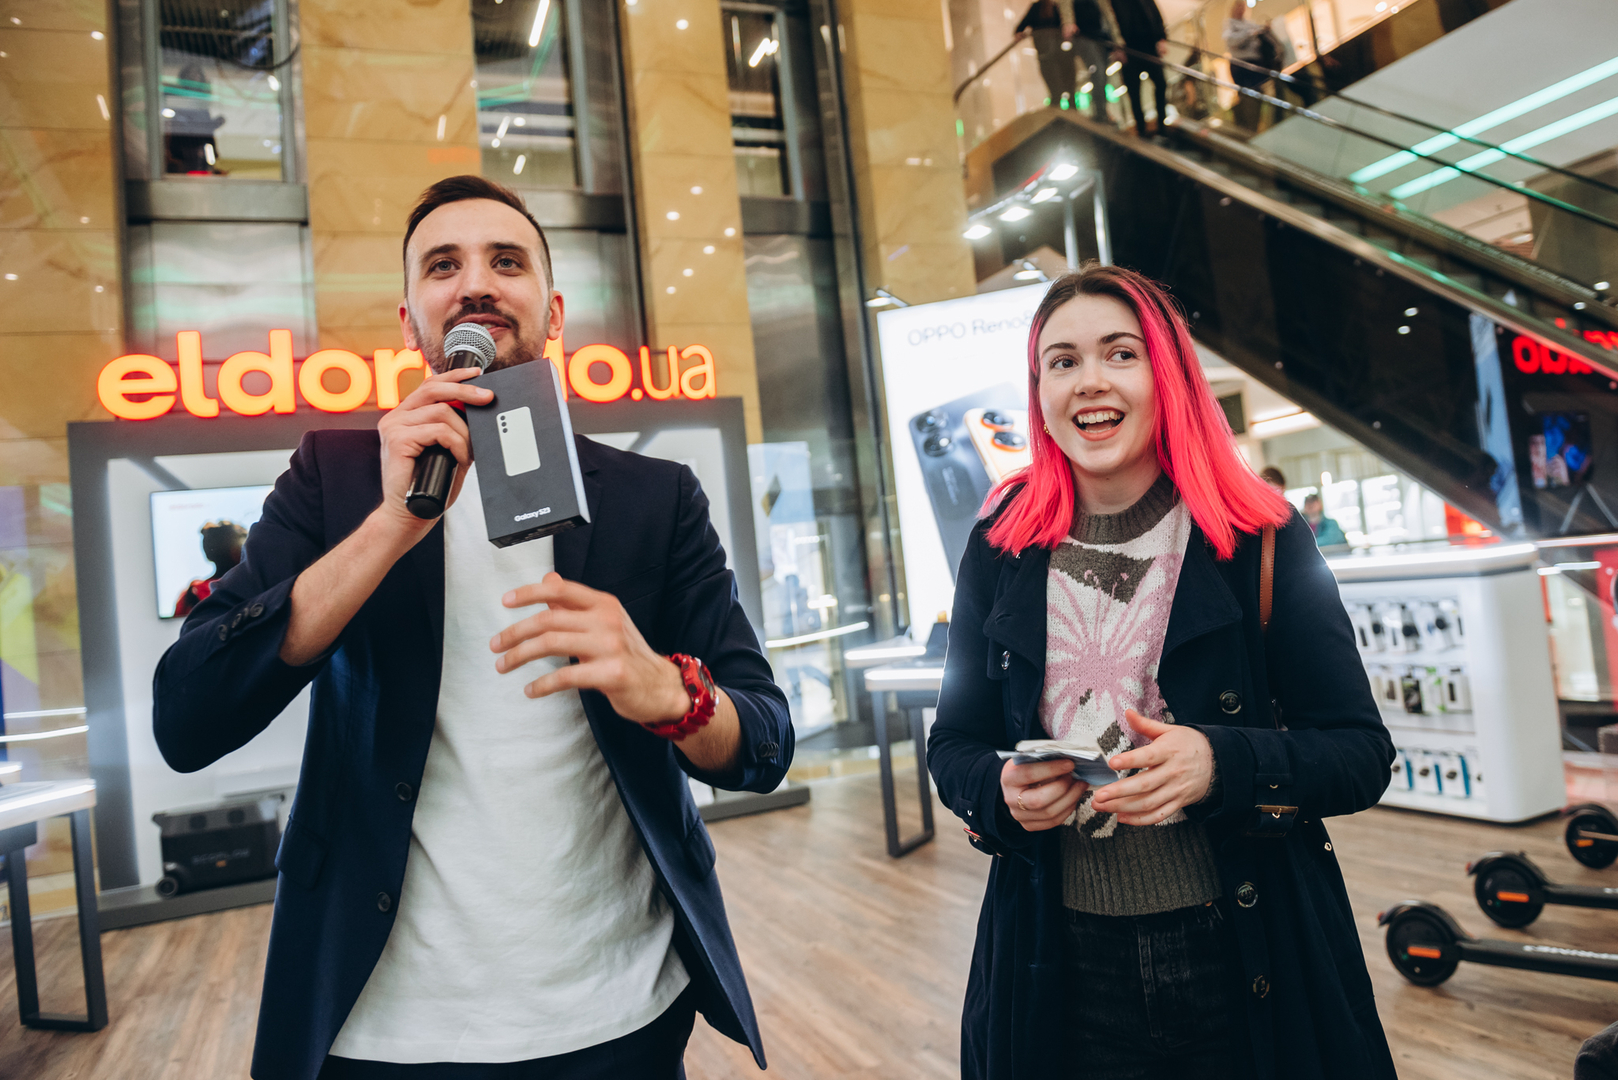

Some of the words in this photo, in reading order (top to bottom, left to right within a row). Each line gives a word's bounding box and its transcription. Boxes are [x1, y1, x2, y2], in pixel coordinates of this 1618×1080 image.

[909, 323, 966, 346] OPPO
[97, 329, 717, 421] eldoro.ua
[514, 511, 539, 522] Galaxy
[538, 507, 551, 516] S23
